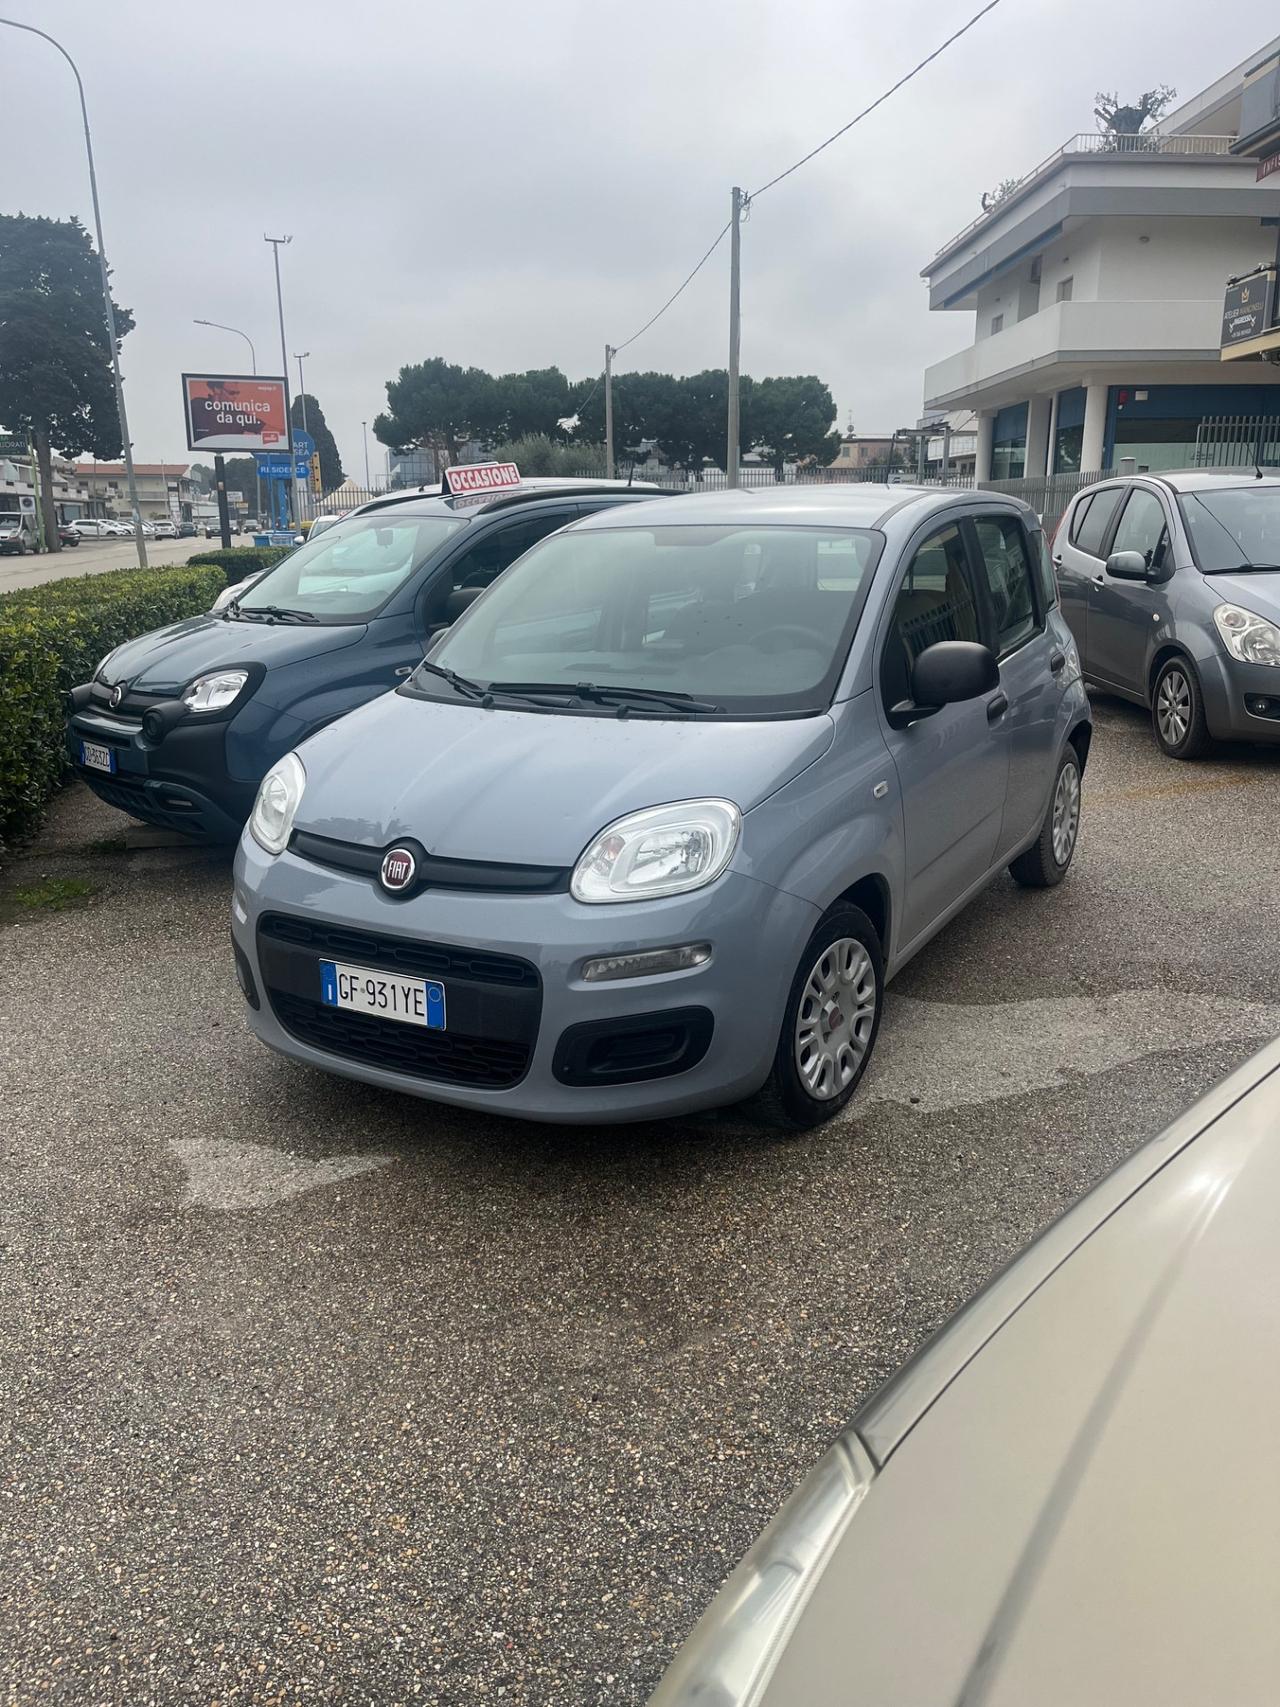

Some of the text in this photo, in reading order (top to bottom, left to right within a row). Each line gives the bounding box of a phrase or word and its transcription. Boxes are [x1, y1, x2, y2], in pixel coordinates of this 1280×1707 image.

[204, 399, 271, 412] comunica
[216, 412, 261, 427] da qui.
[260, 466, 306, 474] RESIDECE
[450, 466, 518, 490] OCCASIONE
[387, 859, 409, 880] FIAT
